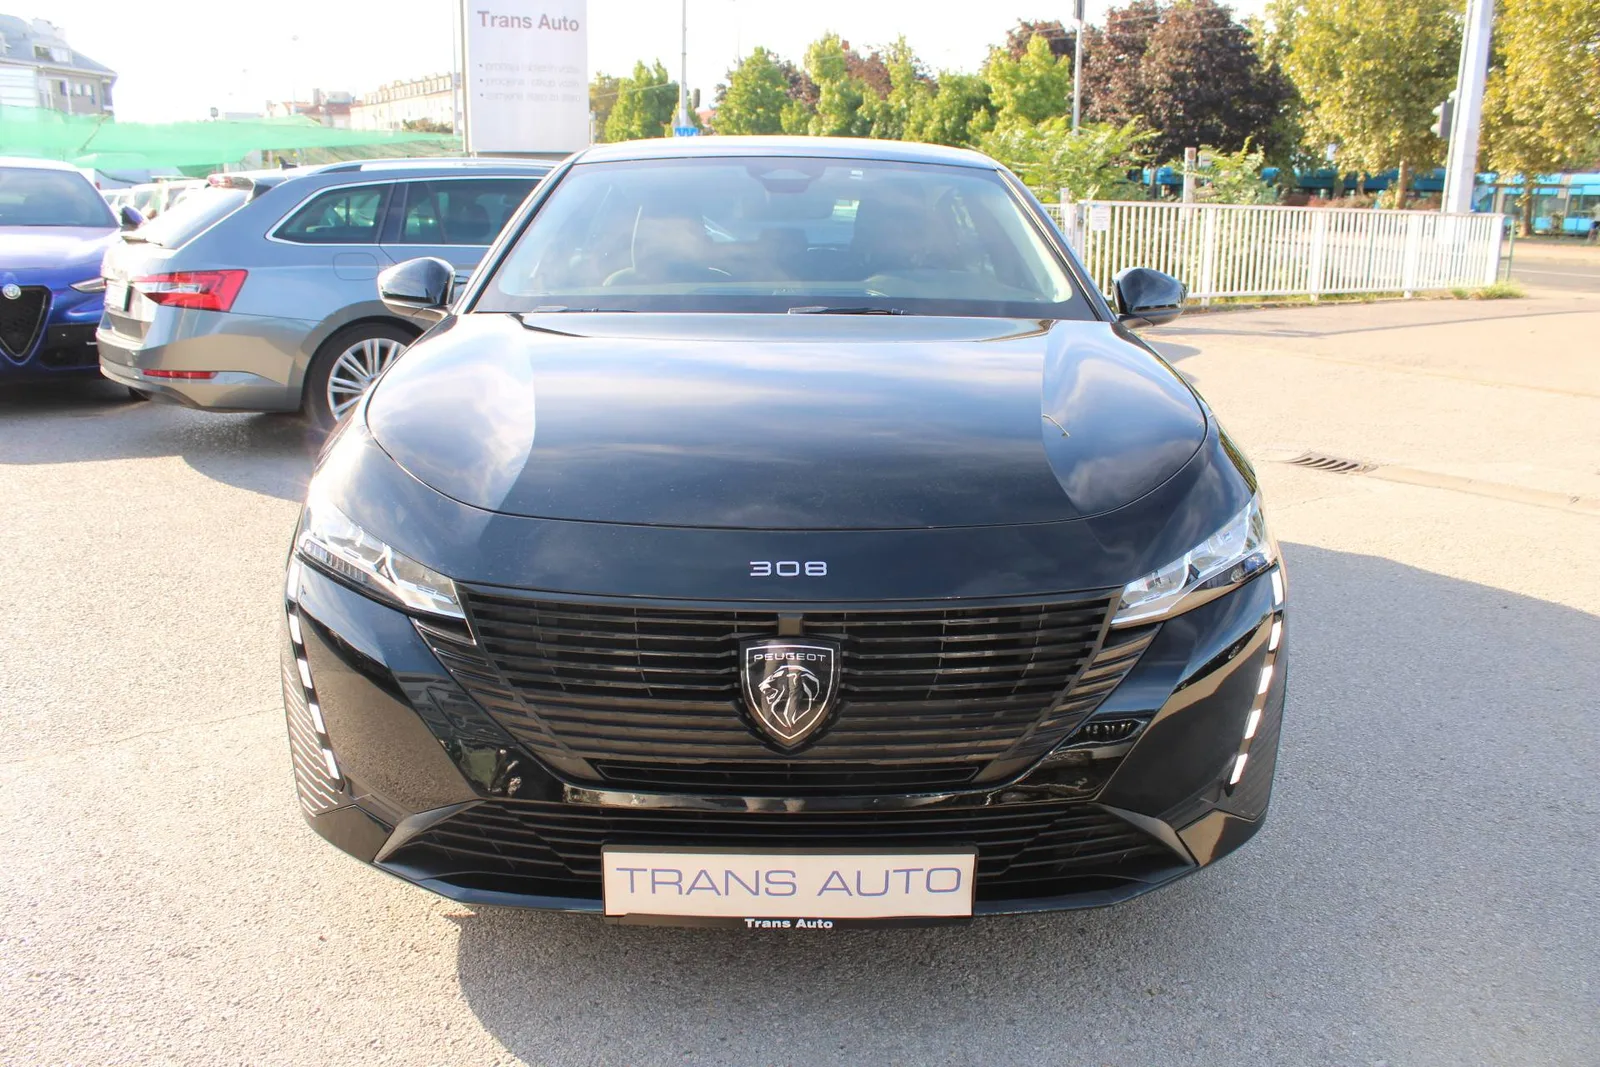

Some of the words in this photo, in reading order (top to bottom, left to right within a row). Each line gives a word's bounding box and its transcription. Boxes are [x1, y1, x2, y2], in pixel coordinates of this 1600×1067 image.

[477, 10, 532, 29] Trans
[538, 13, 580, 32] Auto
[750, 561, 828, 577] 308
[753, 652, 827, 662] PEUGEOT
[615, 867, 798, 897] TRANS
[817, 866, 962, 897] AUTO
[744, 918, 791, 929] Trans
[796, 919, 834, 930] Auto
